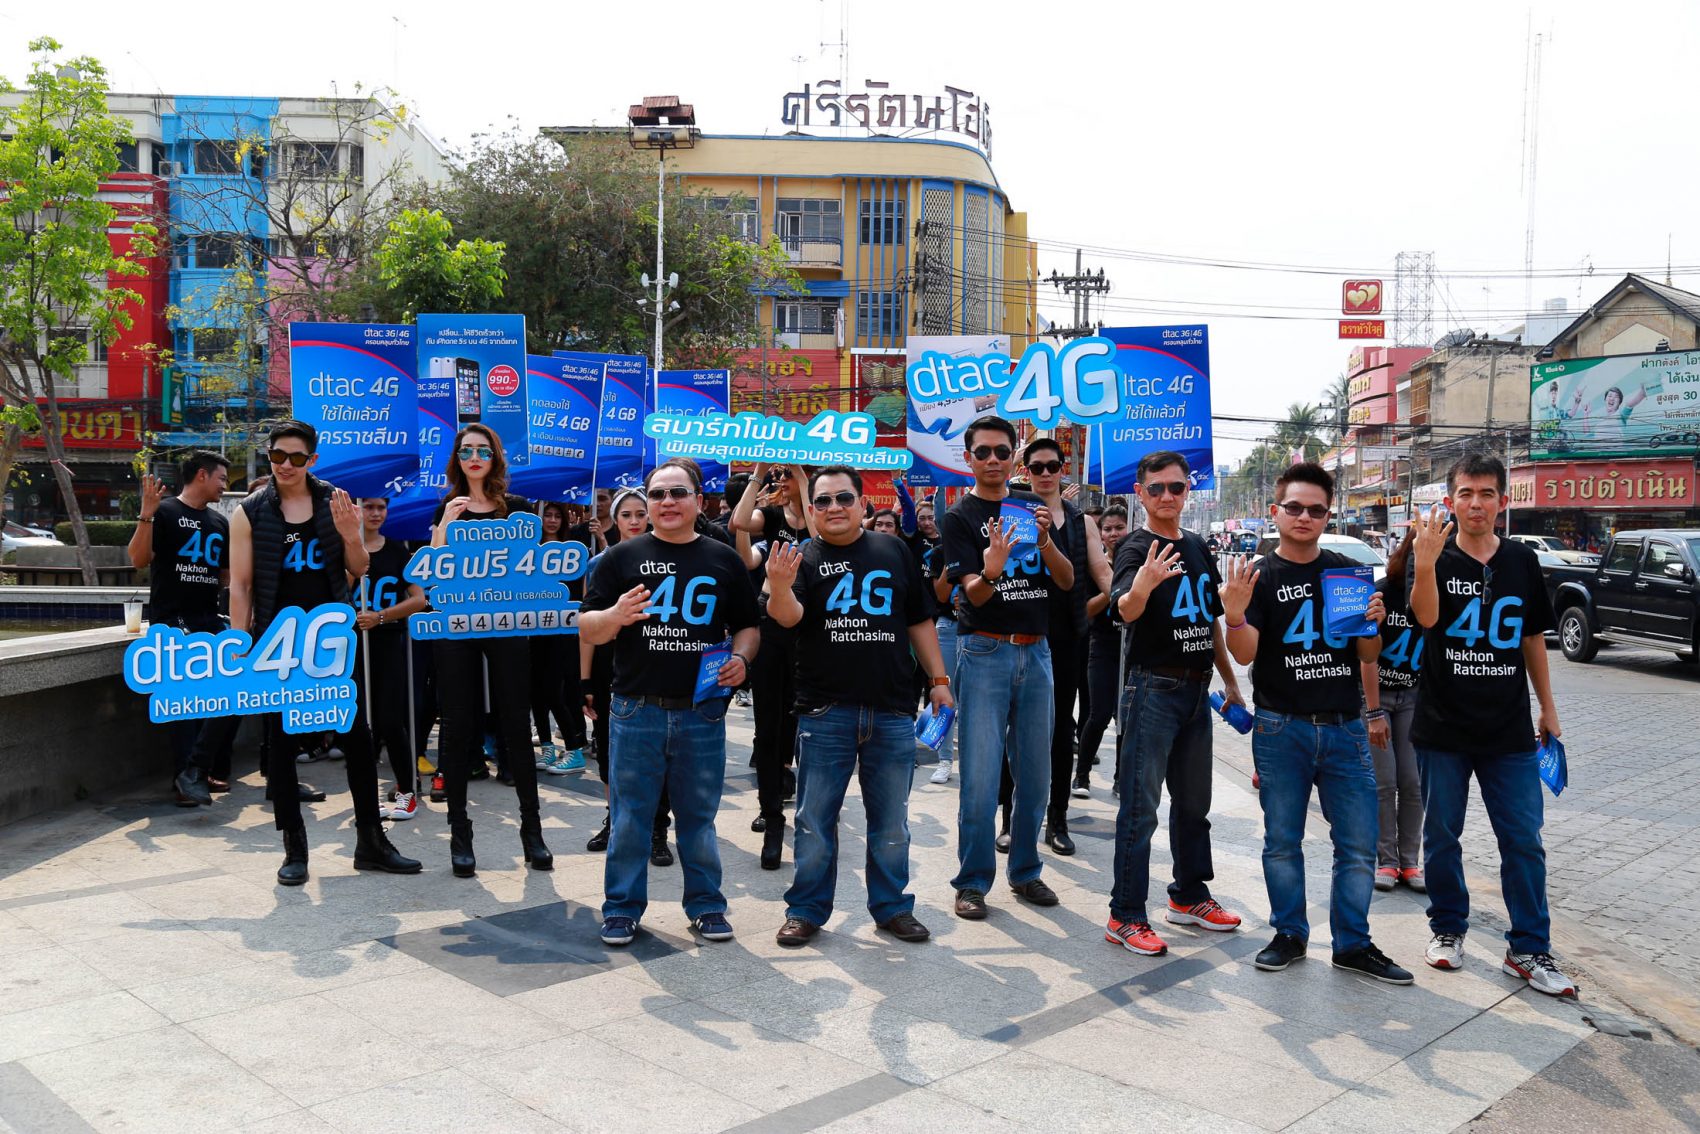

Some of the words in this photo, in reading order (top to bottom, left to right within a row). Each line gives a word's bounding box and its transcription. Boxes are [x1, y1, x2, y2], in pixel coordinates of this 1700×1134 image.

[364, 328, 384, 337] dtac
[1162, 329, 1180, 338] dtac
[562, 364, 578, 373] dtac
[607, 359, 622, 367] dtac
[308, 371, 365, 397] dtac
[369, 376, 400, 397] 4G
[914, 356, 1010, 397] dtac
[1005, 342, 1119, 421] 4G
[1124, 373, 1164, 397] tac
[1167, 374, 1194, 395] 4G
[1683, 390, 1698, 400] 30
[321, 403, 391, 422] ใช้ได้แล้วที่
[606, 407, 616, 420] 4
[618, 407, 637, 421] GB
[1125, 401, 1187, 421] ใช้ได้แล้วที่
[532, 412, 557, 428] ฟรี
[558, 415, 568, 429] 4
[570, 416, 591, 431] GB
[651, 416, 797, 442] สมาร์ทโฟน
[807, 414, 870, 445] 4G
[317, 429, 408, 446] ครราชสีมา
[419, 427, 441, 446] 4G
[1112, 422, 1203, 443] นครราชสีมา
[402, 480, 416, 488] dtac
[1545, 470, 1687, 499] ราชดำเนิน
[178, 516, 202, 530] dtac
[454, 519, 535, 542] ทดลองใช้
[178, 530, 224, 567] 4G
[175, 563, 208, 574] Nakhon
[411, 553, 456, 581] 4G
[462, 548, 509, 578] ฟรี
[515, 549, 536, 576] 4
[541, 548, 582, 575] GB
[640, 560, 677, 575] dtac
[819, 560, 853, 577] dtac
[825, 569, 894, 616] 4G
[1276, 582, 1313, 603] dtac
[1333, 585, 1355, 596] dtac
[1356, 586, 1368, 594] 4G
[1446, 576, 1482, 595] dtac
[437, 593, 464, 605] นาน
[468, 592, 476, 602] 4
[480, 588, 513, 602] เดือน
[642, 575, 719, 626] 4G
[417, 619, 442, 634] กด
[824, 617, 869, 630] Nakhon
[1445, 595, 1524, 649] 4G
[642, 625, 688, 638] Nakhon
[831, 630, 896, 643] Ratchasima
[1173, 626, 1211, 641] Nakhon
[132, 632, 244, 685] dtac
[252, 611, 349, 681] 4G
[1445, 648, 1495, 663] Nakhon
[1284, 652, 1332, 669] Nakhon
[155, 693, 230, 717] Nakhon
[236, 683, 351, 709] Ratchasima
[288, 706, 350, 728] Ready
